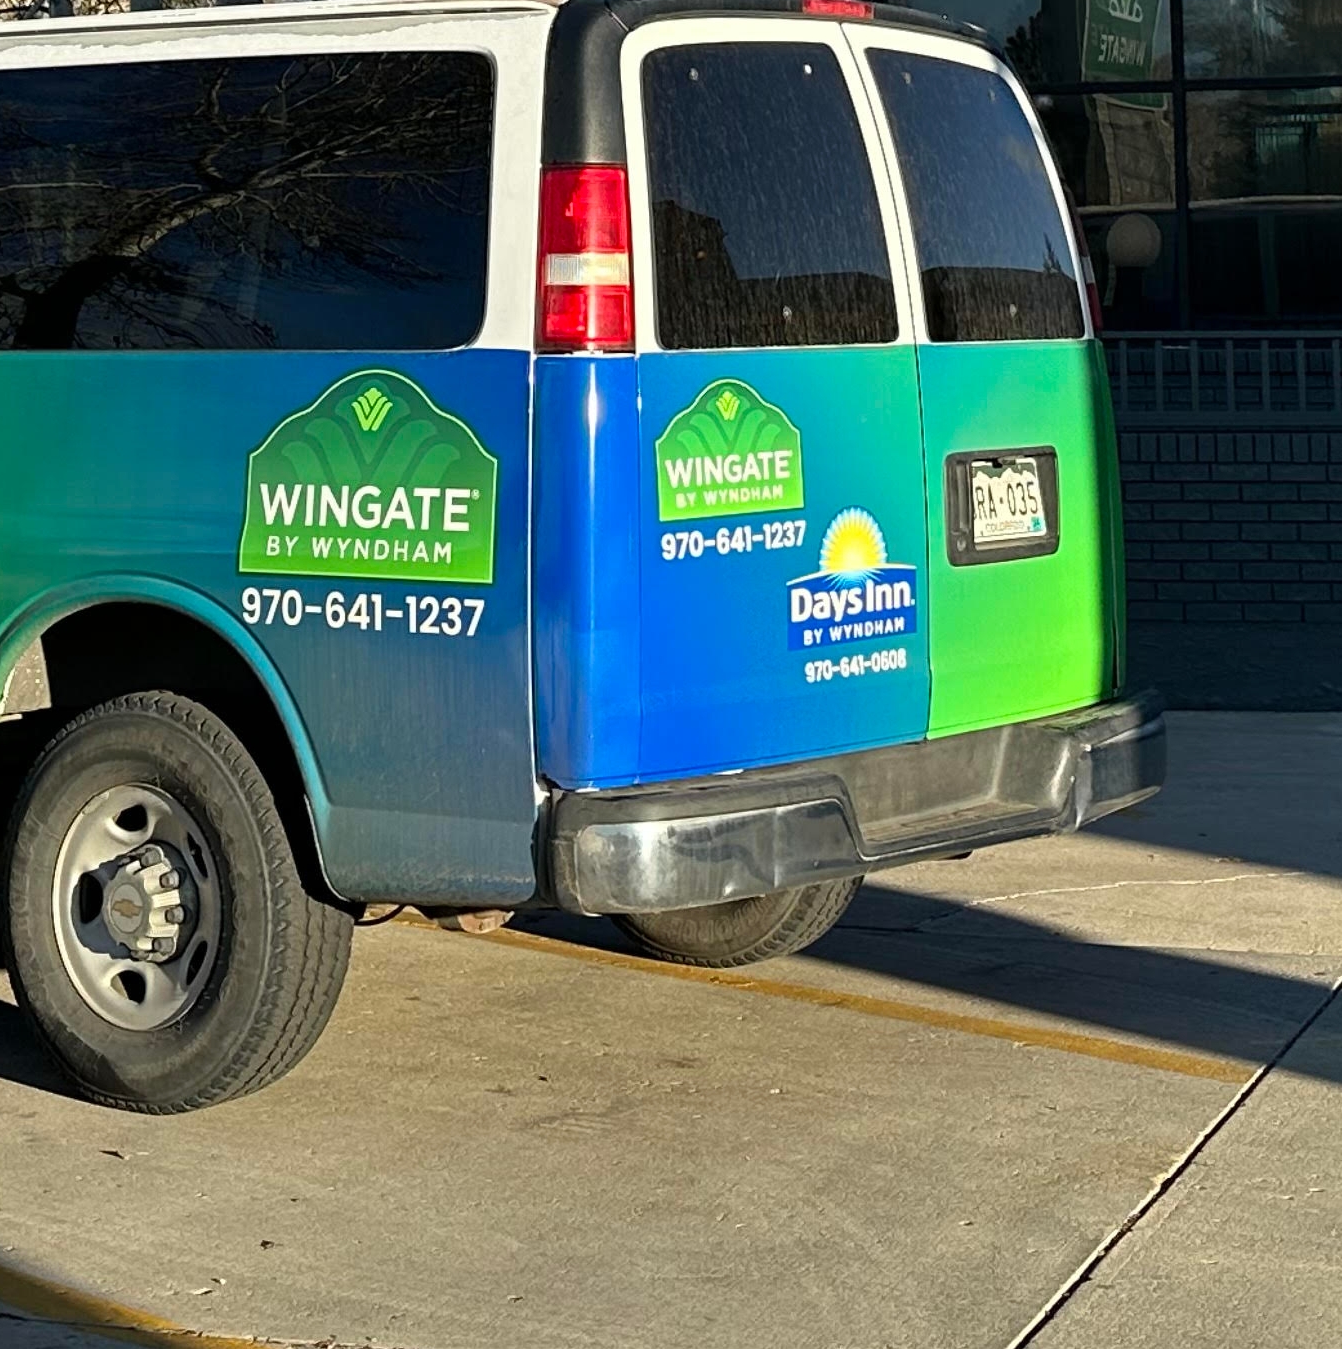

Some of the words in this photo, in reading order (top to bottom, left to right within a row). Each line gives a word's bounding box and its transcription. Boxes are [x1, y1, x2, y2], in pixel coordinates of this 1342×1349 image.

[664, 449, 793, 488] WINGATE
[260, 483, 471, 531] WINGATE
[675, 492, 696, 509] BY
[704, 484, 783, 506] WYNDHAM
[266, 536, 299, 557] BY
[312, 537, 452, 564] WYNDHAM
[661, 519, 807, 561] 970-641-1237
[241, 587, 485, 636] 970-641-1237
[791, 588, 863, 623] Days
[866, 579, 911, 612] Inn
[803, 628, 823, 646] BY
[829, 616, 905, 642] WYNDHAM
[804, 648, 907, 684] 970-641-0608
